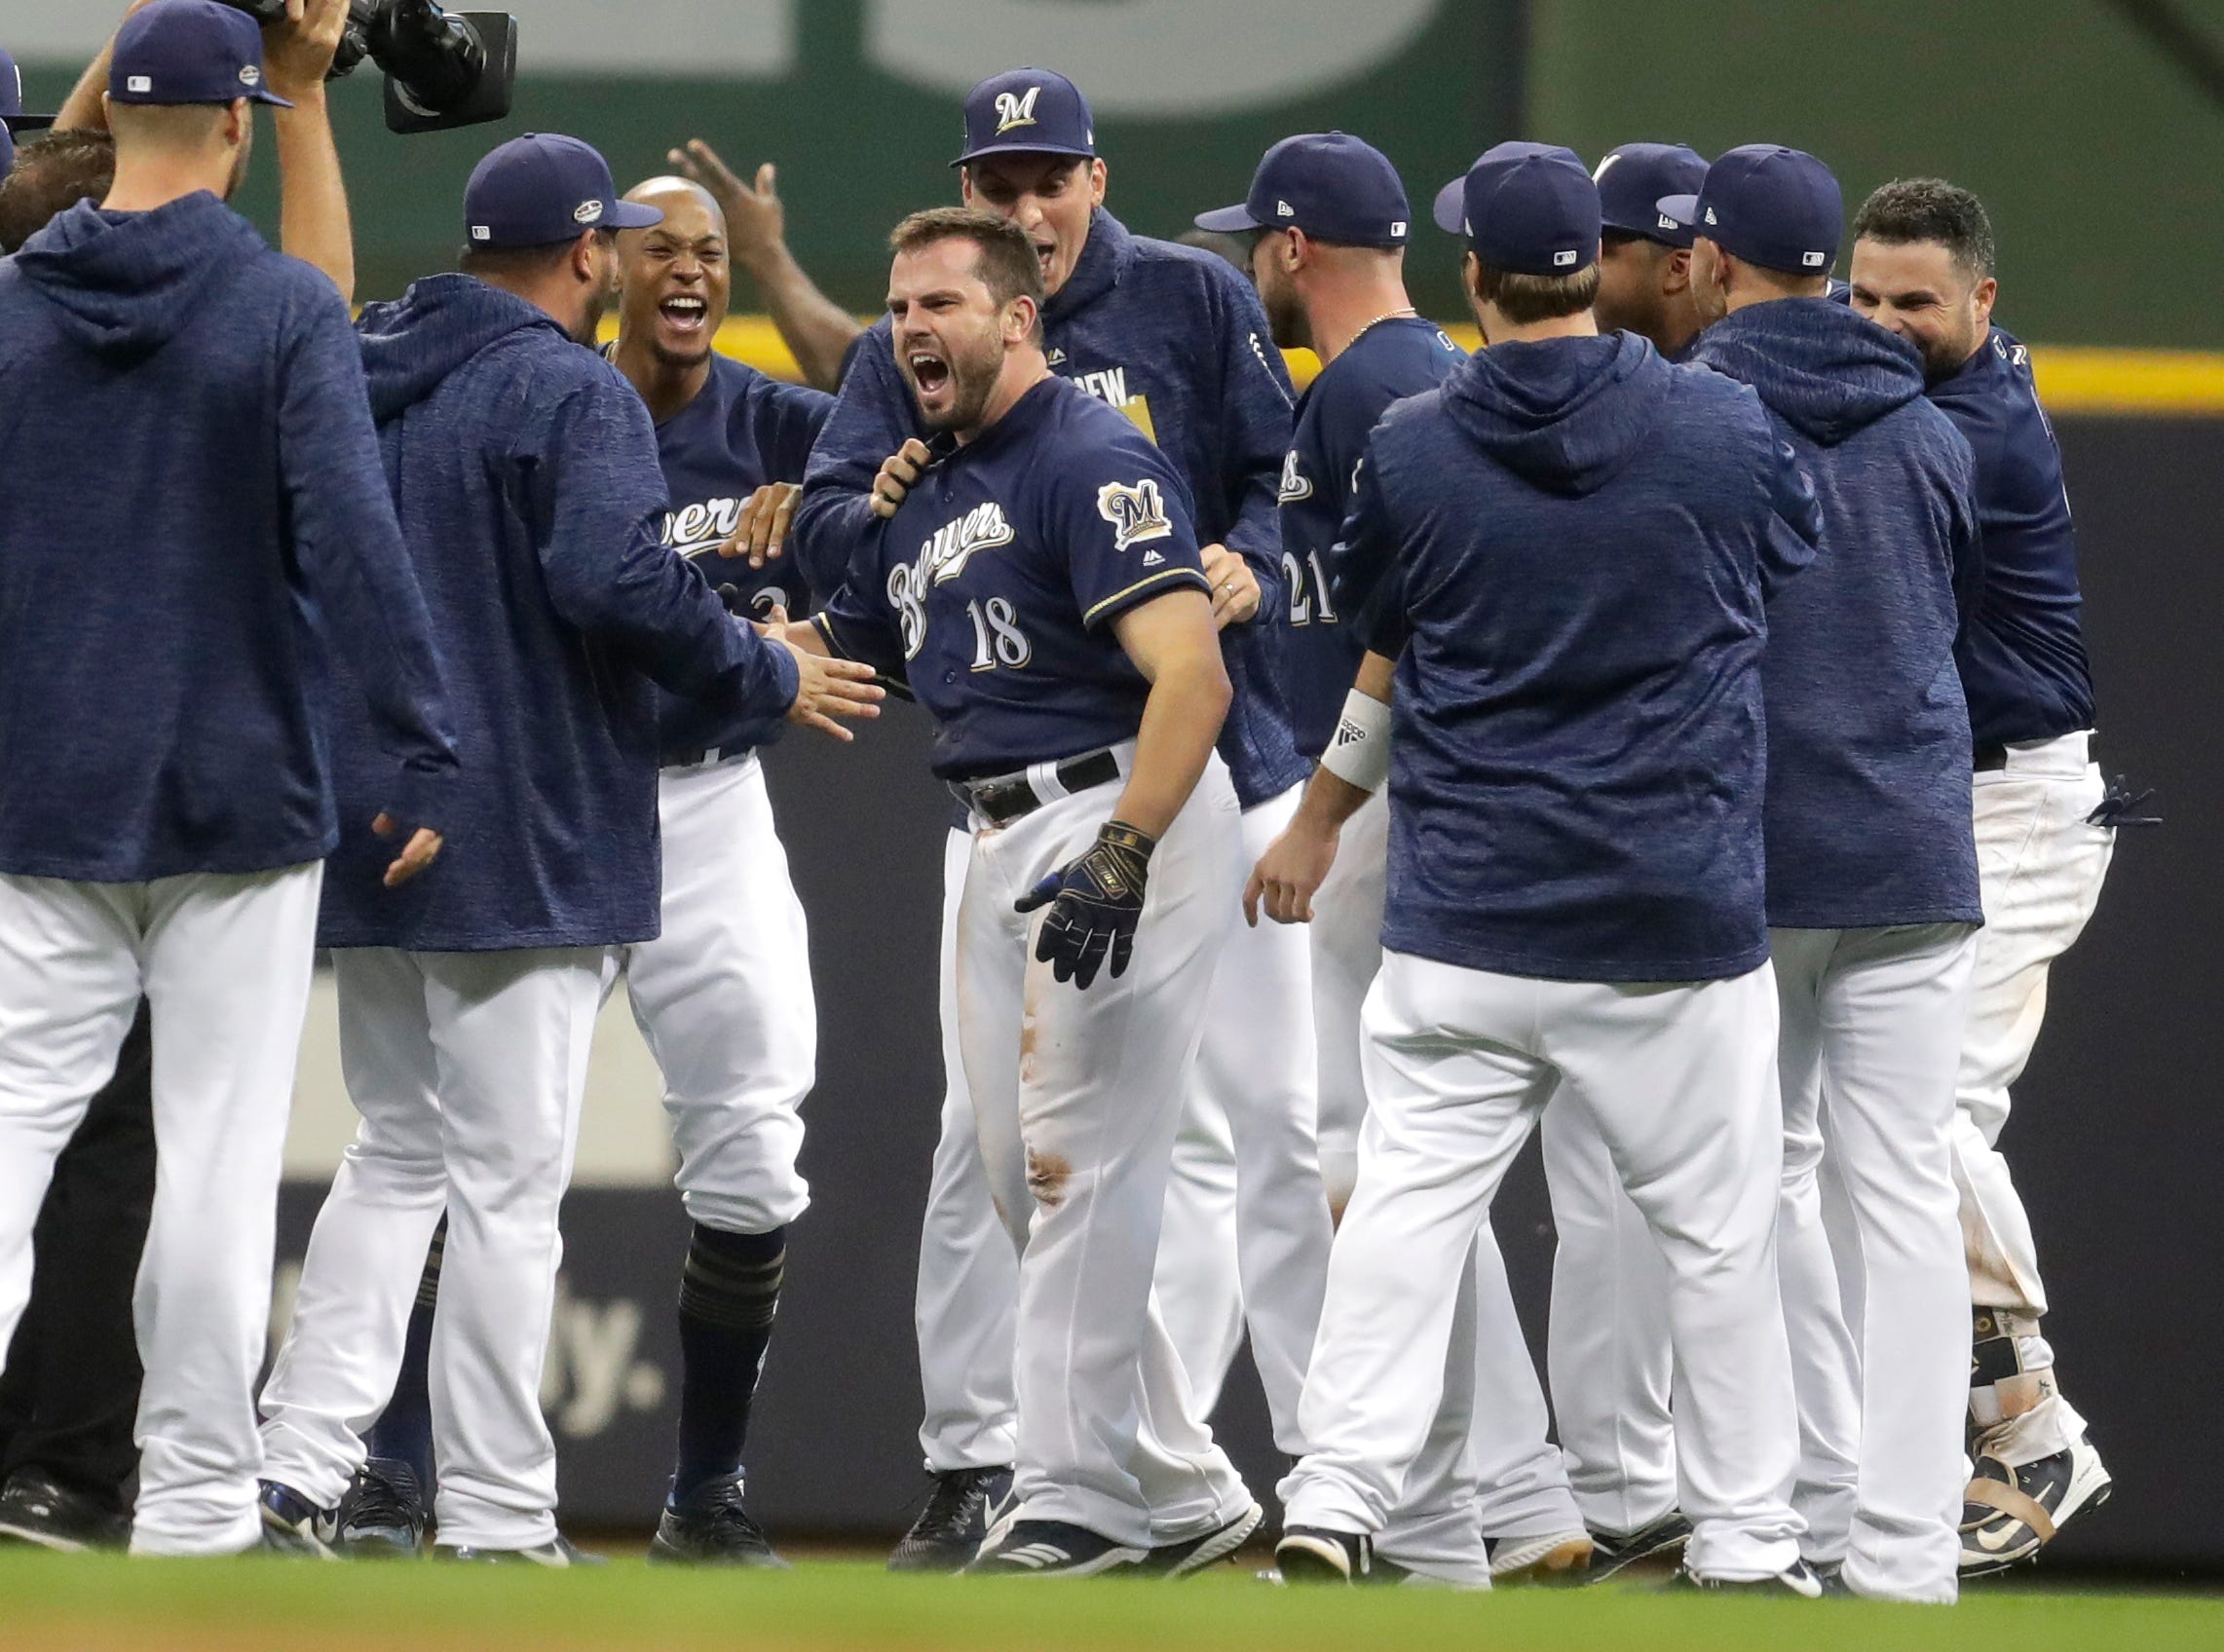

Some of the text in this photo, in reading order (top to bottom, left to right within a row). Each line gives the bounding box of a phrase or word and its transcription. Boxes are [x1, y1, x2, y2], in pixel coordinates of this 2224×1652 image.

[995, 86, 1041, 134] M
[1108, 483, 1167, 542] M
[886, 502, 1015, 662] Brewers
[1281, 547, 1338, 626] 21
[966, 598, 1032, 672] 18
